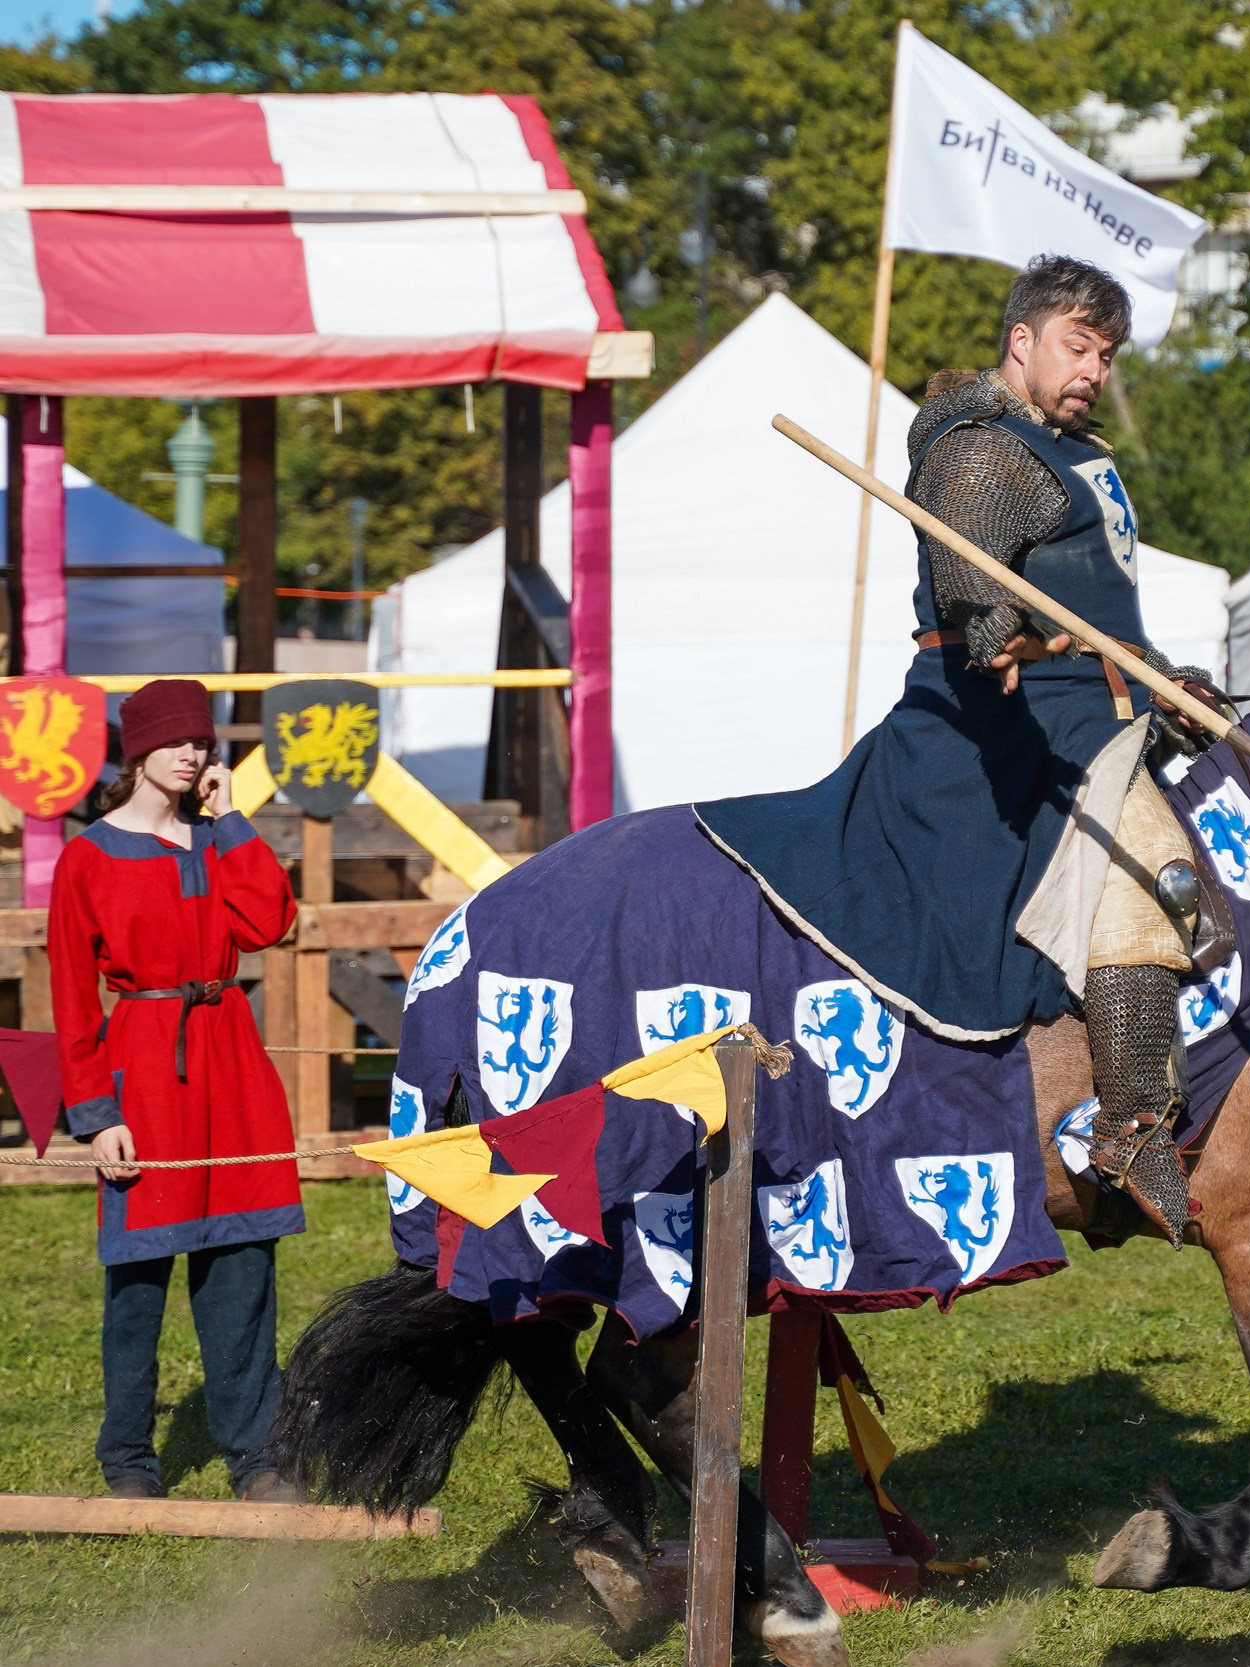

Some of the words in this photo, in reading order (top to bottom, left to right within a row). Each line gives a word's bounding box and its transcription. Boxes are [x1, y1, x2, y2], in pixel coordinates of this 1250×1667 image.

[940, 118, 1036, 187] Битва
[1045, 170, 1077, 203] на
[1082, 191, 1153, 258] Неве
